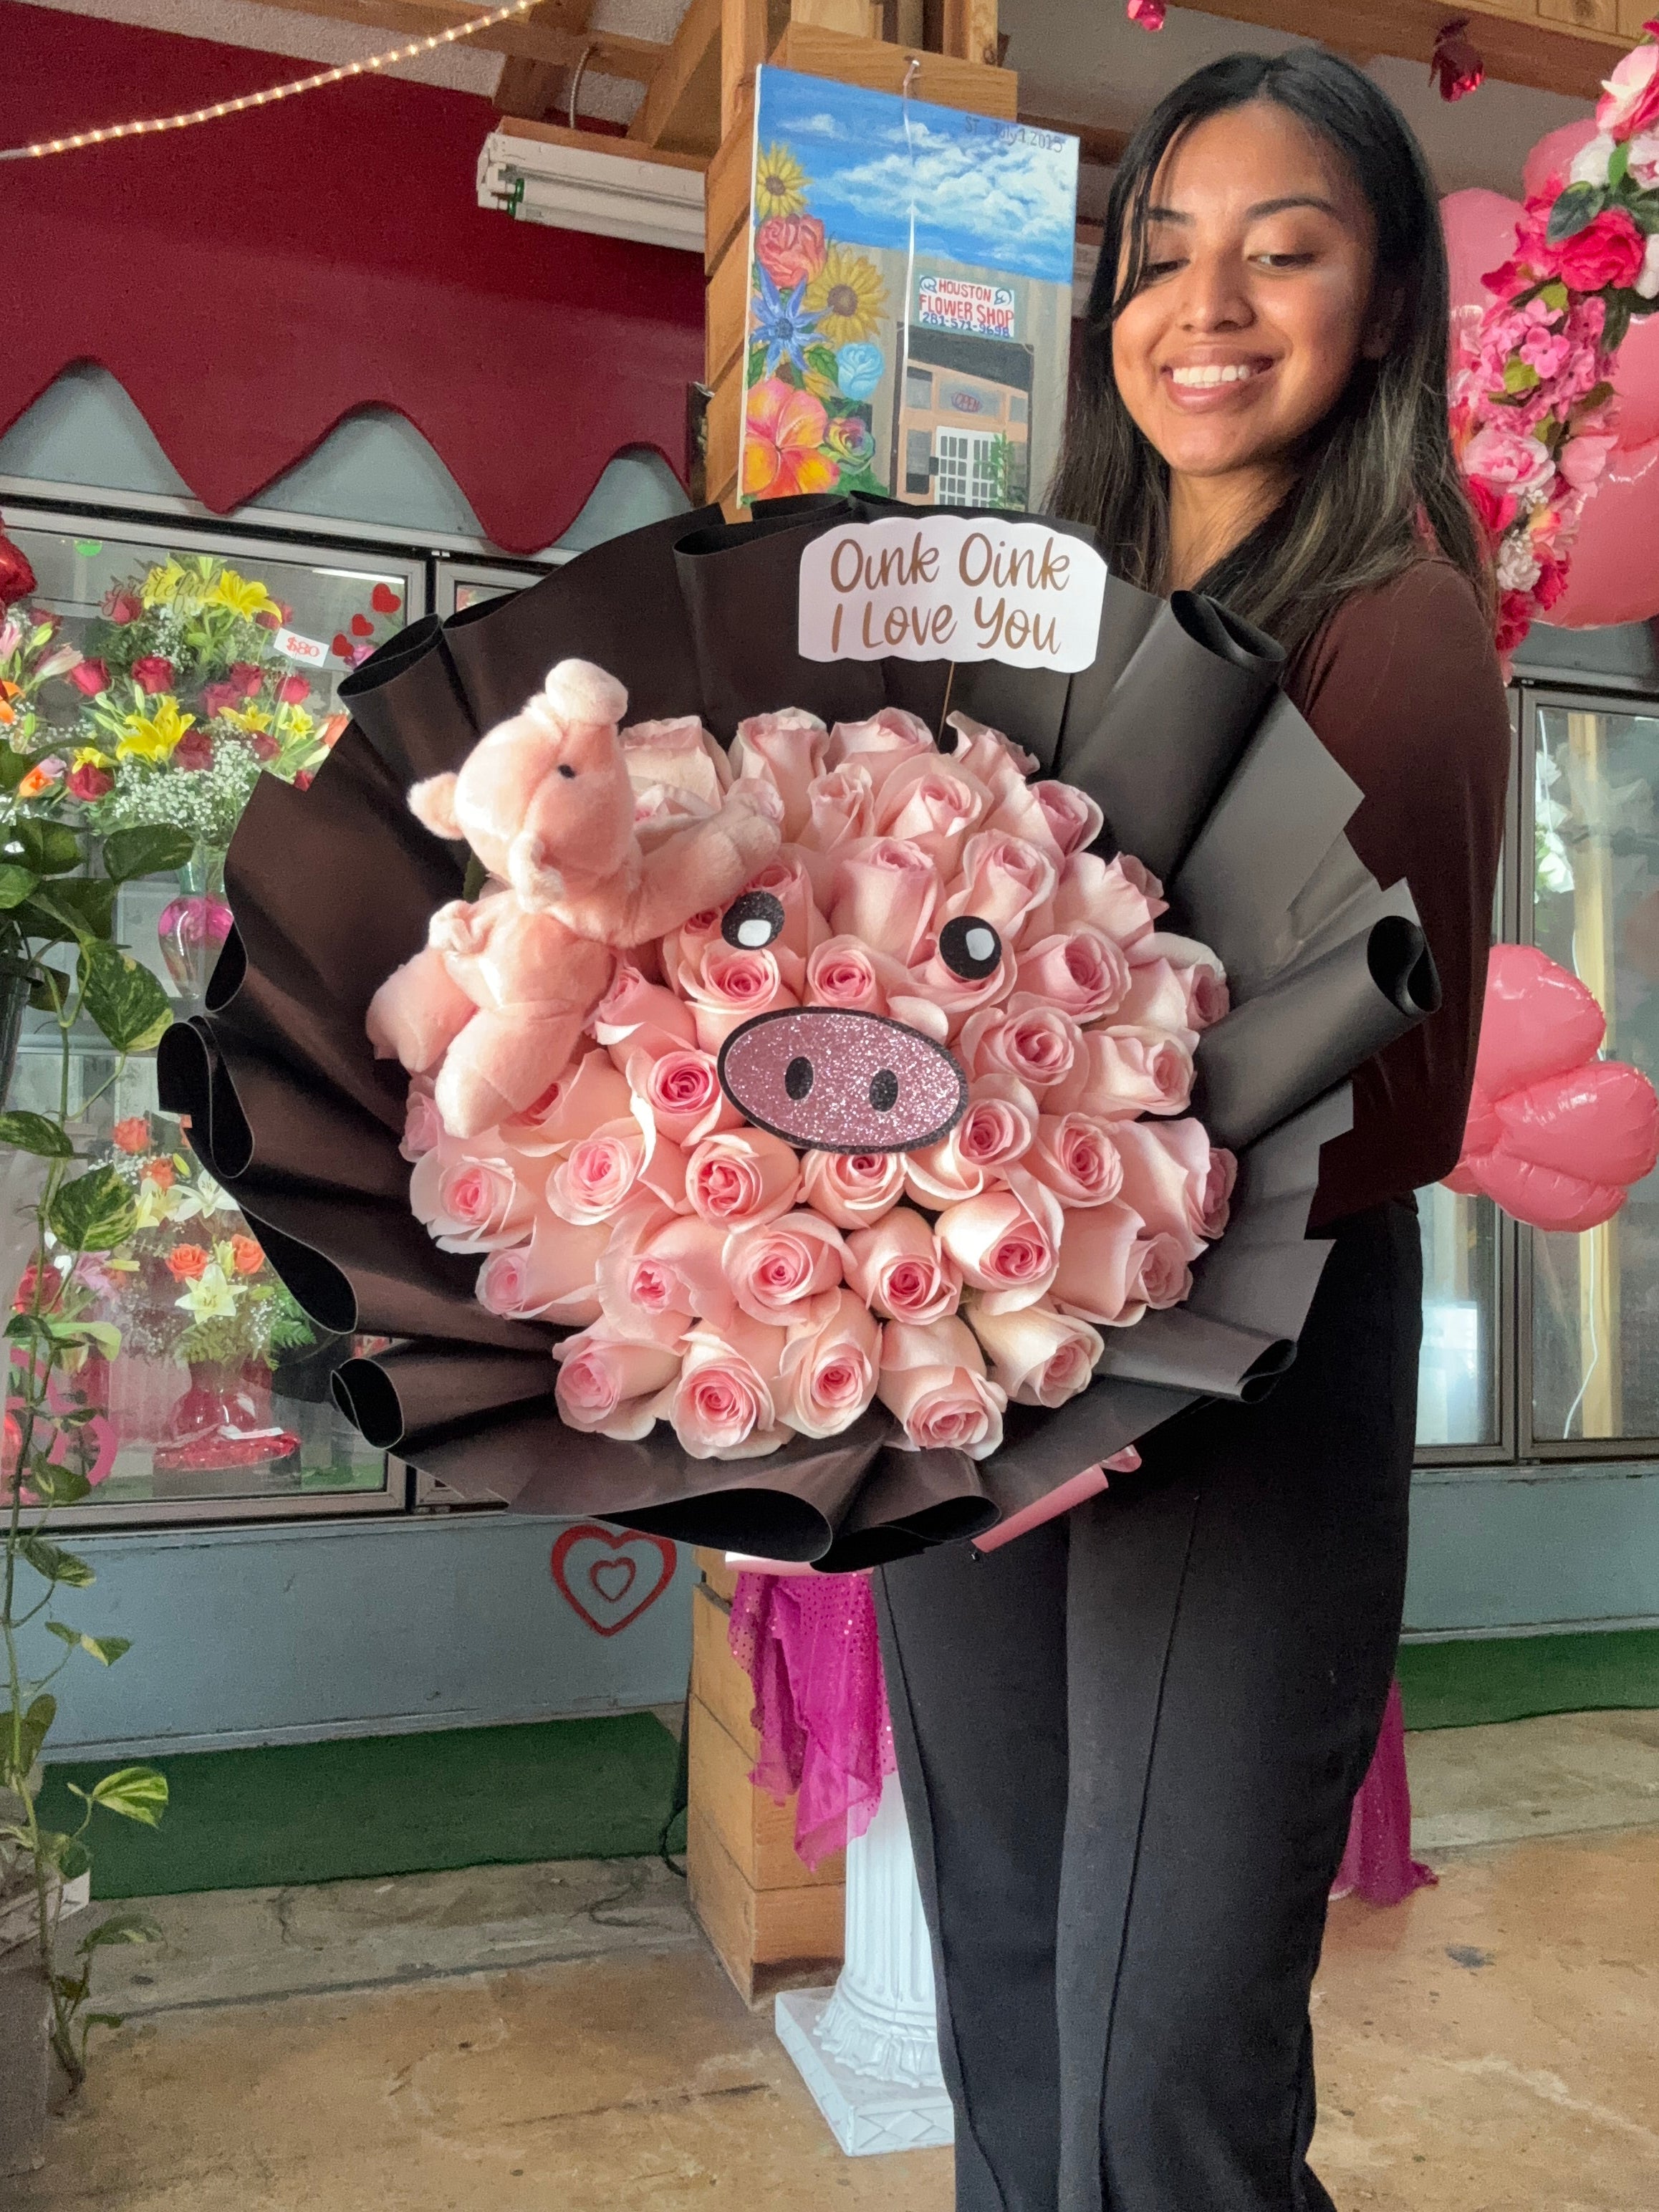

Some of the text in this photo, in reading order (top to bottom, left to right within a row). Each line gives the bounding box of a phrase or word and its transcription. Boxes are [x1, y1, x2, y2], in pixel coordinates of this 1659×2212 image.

[938, 279, 992, 302] HOUSTON
[919, 294, 1014, 328] FLOWER SHOP
[923, 312, 1010, 338] 281-571-9698
[958, 532, 1070, 591] Oink
[102, 568, 221, 617] grateful
[831, 596, 1062, 655] I Love You
[287, 636, 320, 658] $80
